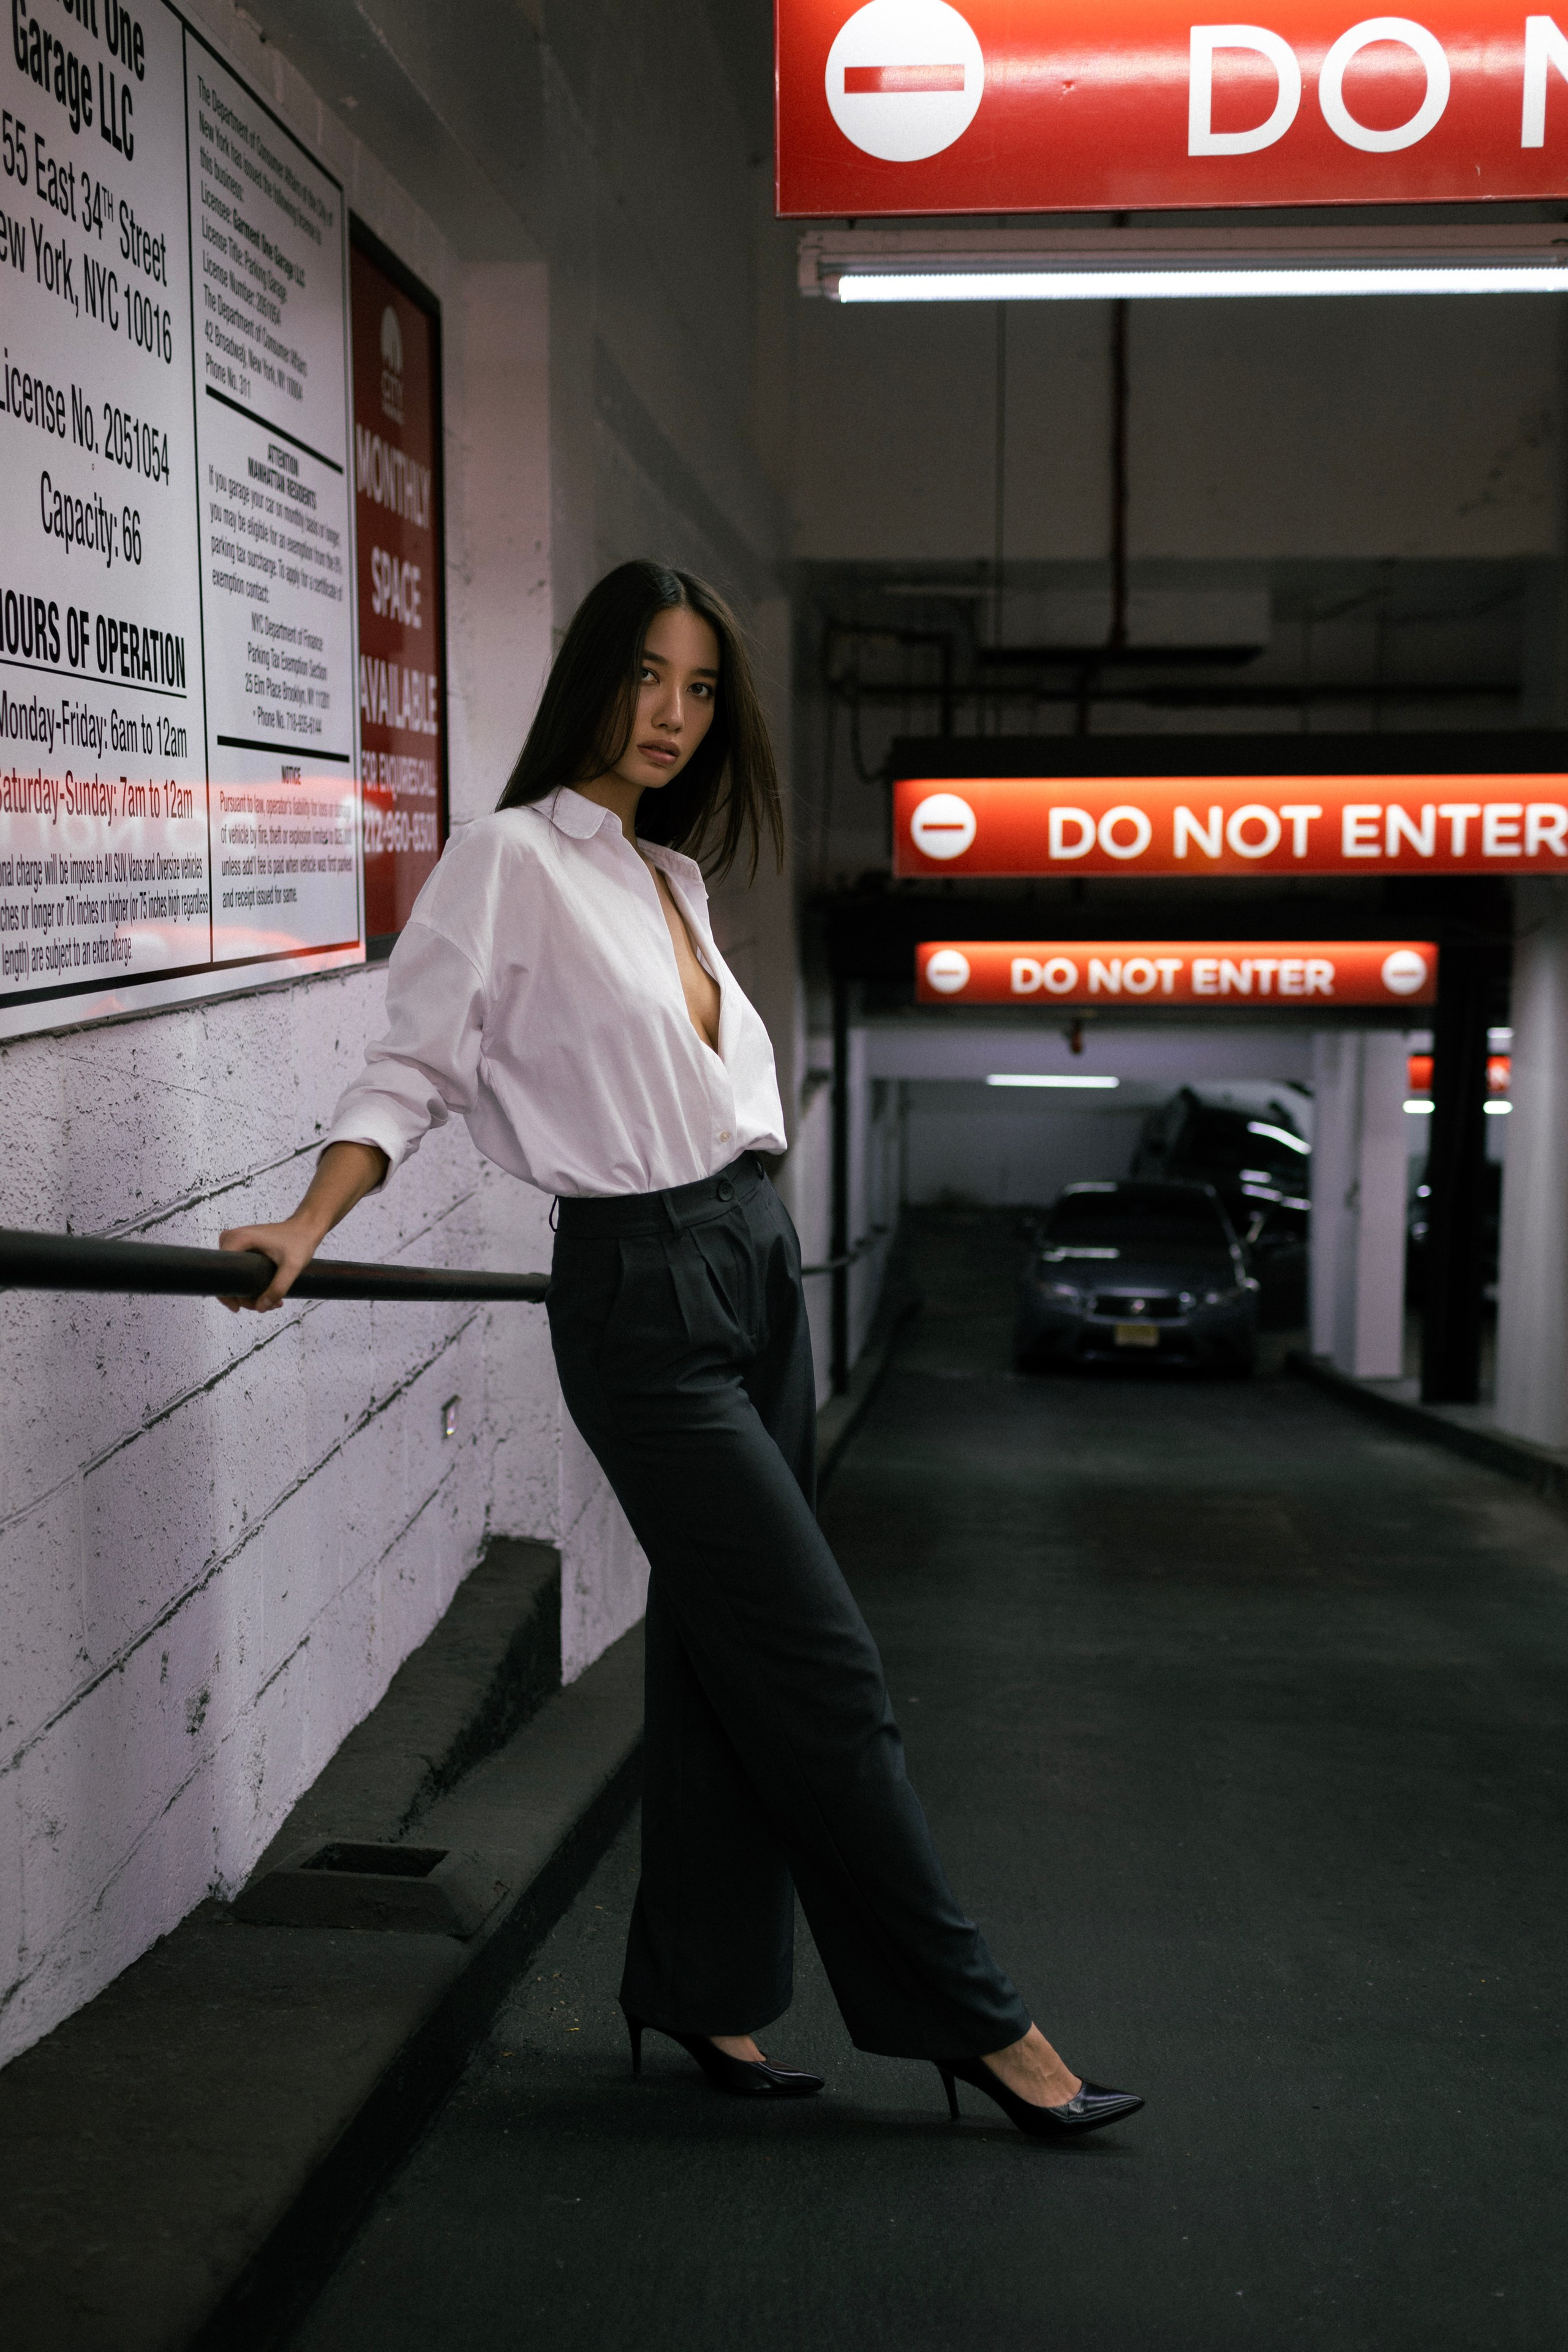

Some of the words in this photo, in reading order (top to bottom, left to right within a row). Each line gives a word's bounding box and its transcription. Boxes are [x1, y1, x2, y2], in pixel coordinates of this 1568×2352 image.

[11, 0, 92, 135] Garage
[98, 62, 134, 162] LLC
[104, 0, 145, 81] One
[1188, 17, 1450, 157] DO
[34, 132, 77, 222] East
[119, 199, 167, 287] Street
[0, 209, 26, 273] ew
[30, 216, 79, 318] York,
[83, 253, 119, 331] NYC
[124, 284, 172, 364] 10016
[71, 383, 99, 454] No.
[104, 402, 170, 486] 2051054
[355, 420, 432, 534] MONTHLY
[40, 470, 118, 568] Capacity:
[123, 506, 141, 565] 66
[371, 542, 423, 632] SPACE
[0, 587, 61, 663] OURS
[67, 606, 90, 669] OF
[96, 614, 186, 689] OPERATION
[110, 709, 138, 753] 6am
[141, 714, 153, 755] to
[156, 716, 187, 758] 12am
[359, 651, 438, 736] AVAILABLE
[0, 765, 117, 827] aturday-Sunday:
[119, 776, 146, 818] 7am
[149, 778, 160, 818] to
[164, 779, 193, 819] 12am
[219, 790, 246, 812] Pursuant
[1048, 804, 1152, 859] DO
[1174, 804, 1323, 859] NOT
[1341, 802, 1568, 858] ENTER
[0, 854, 14, 887] nal
[16, 854, 43, 893] charge
[43, 853, 58, 885] will
[59, 853, 69, 885] be
[70, 853, 95, 891] impose
[96, 854, 104, 883] to
[104, 853, 113, 883] All
[144, 853, 156, 881] and
[156, 852, 180, 881] Oversize
[181, 853, 203, 880] vehicles
[221, 856, 241, 875] unless
[222, 888, 234, 908] and
[235, 887, 255, 910] receipt
[255, 886, 274, 905] issued
[21, 905, 29, 930] or
[31, 897, 55, 935] longer
[56, 902, 64, 927] or
[66, 895, 75, 926] 70
[77, 894, 99, 925] inches
[100, 900, 107, 924] or
[108, 892, 129, 929] higher
[130, 892, 138, 927] (or
[139, 891, 147, 919] 75
[148, 890, 167, 919] inches
[168, 889, 180, 923] high
[181, 888, 208, 922] regardless
[2, 941, 29, 982] length)
[31, 946, 43, 973] are
[45, 937, 72, 976] subject
[73, 937, 80, 967] to
[82, 941, 91, 966] an
[92, 934, 110, 964] extra
[110, 932, 132, 967] charge.
[1011, 957, 1078, 994] DO
[1088, 957, 1182, 995] NOT
[1192, 957, 1335, 996] ENTER
